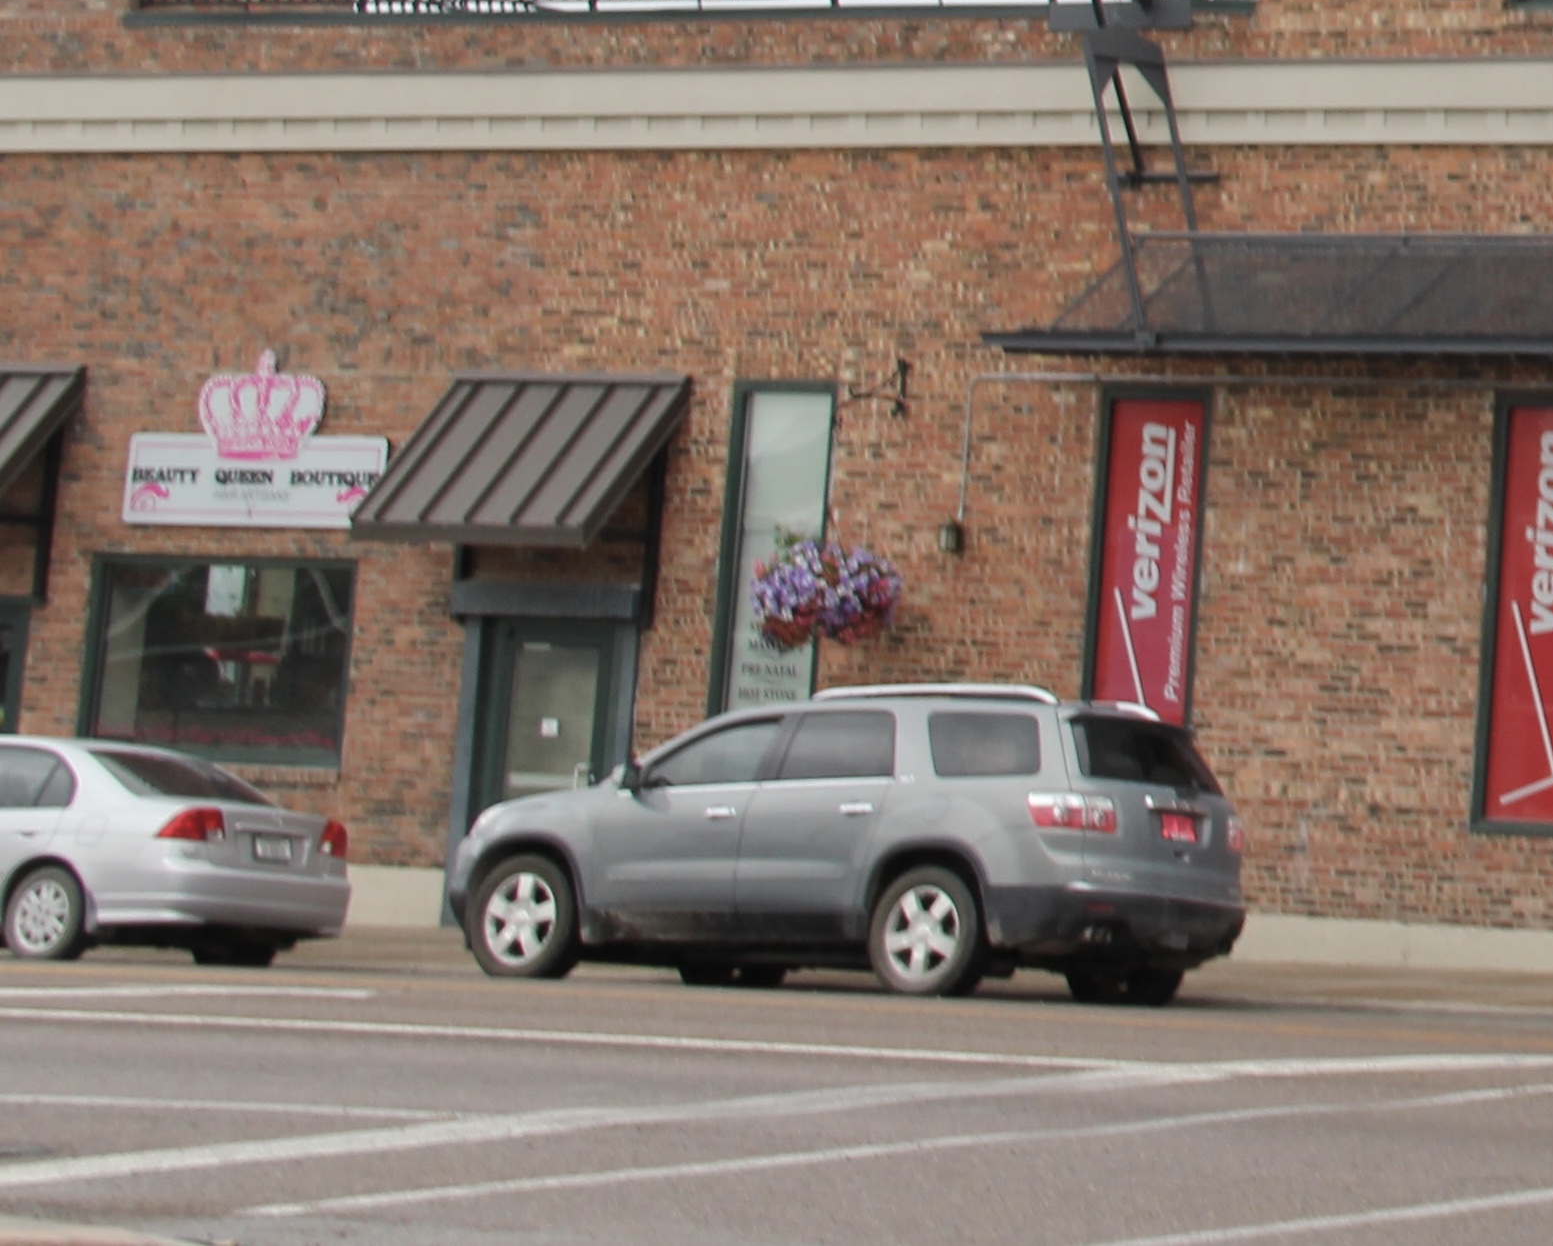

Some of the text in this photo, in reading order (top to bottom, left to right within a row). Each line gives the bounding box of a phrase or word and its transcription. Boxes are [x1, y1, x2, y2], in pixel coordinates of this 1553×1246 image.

[132, 466, 199, 484] BEAUTY
[214, 468, 274, 485] QUEEN
[1127, 421, 1177, 621] verizon
[1164, 418, 1197, 703] Premium Wireless Retailer
